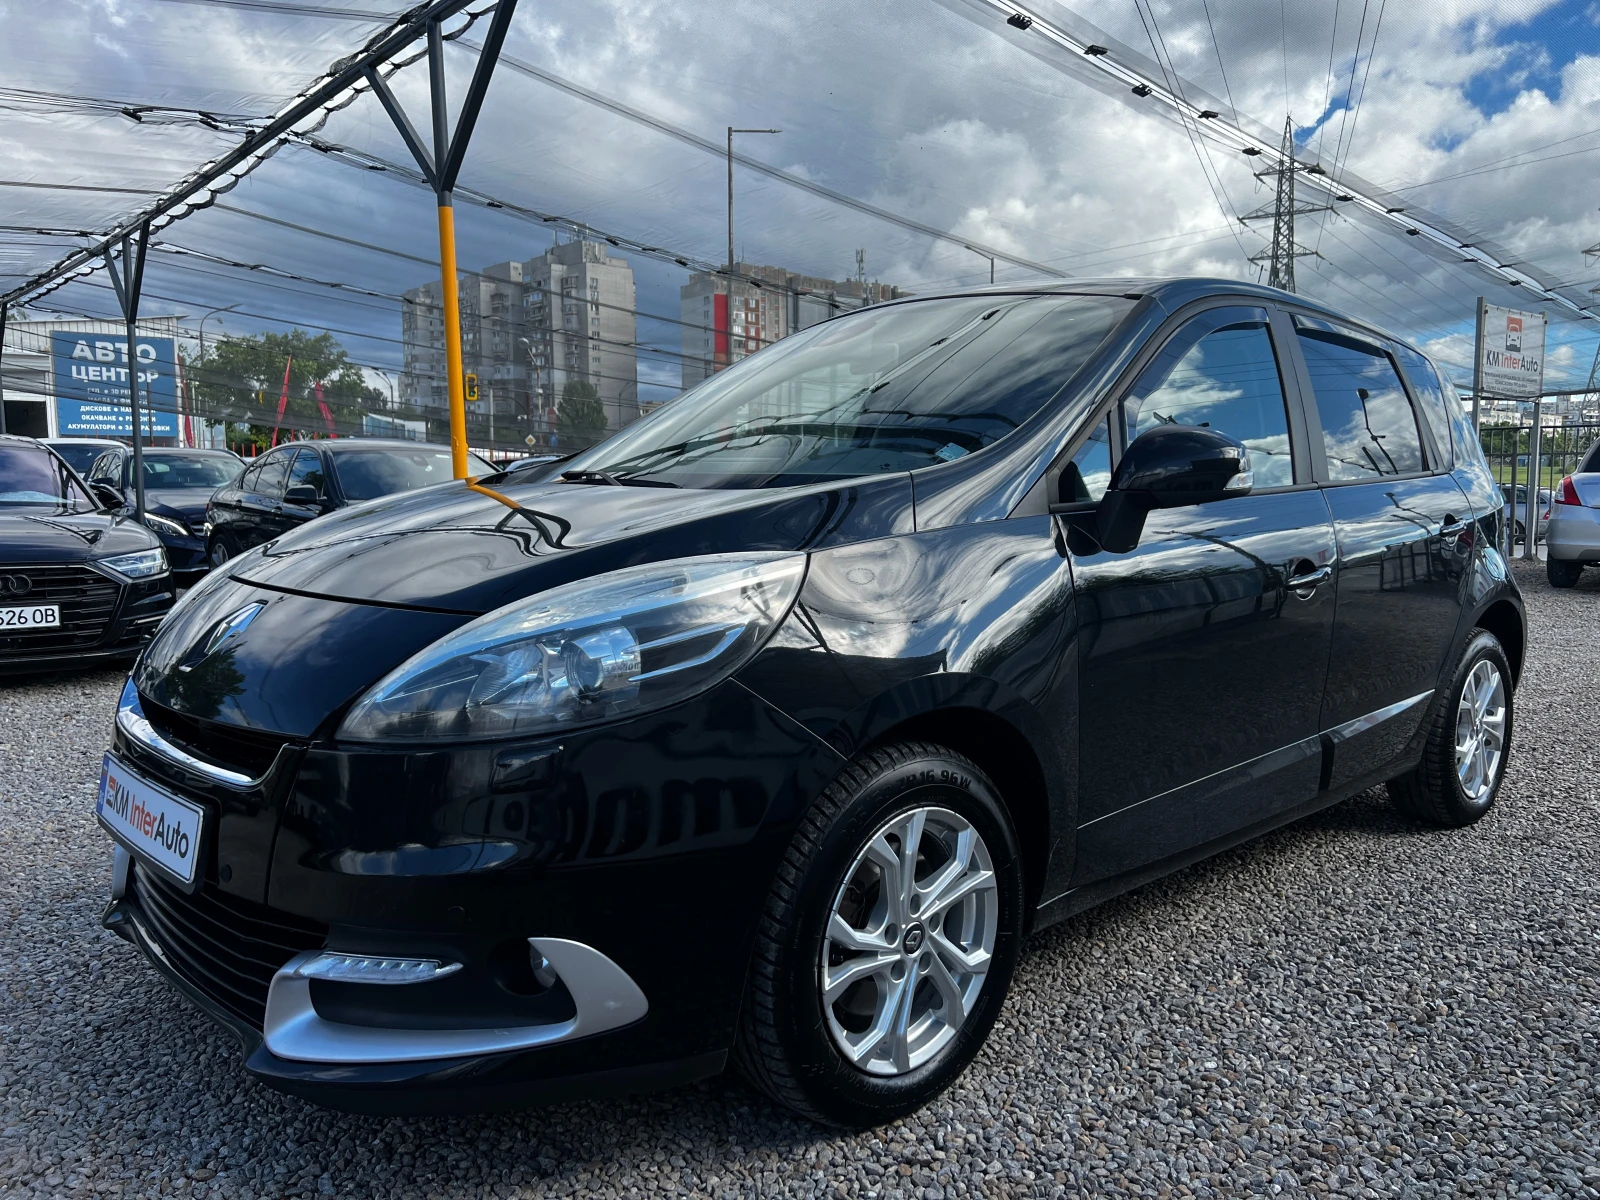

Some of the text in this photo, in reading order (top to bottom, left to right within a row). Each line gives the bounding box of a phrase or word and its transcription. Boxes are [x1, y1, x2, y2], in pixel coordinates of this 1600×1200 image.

[72, 340, 156, 364] АВТО
[1486, 350, 1539, 372] KM InterAuto
[81, 414, 117, 422] ОКАЧВАНЕ
[113, 782, 189, 858] KM InterAuto
